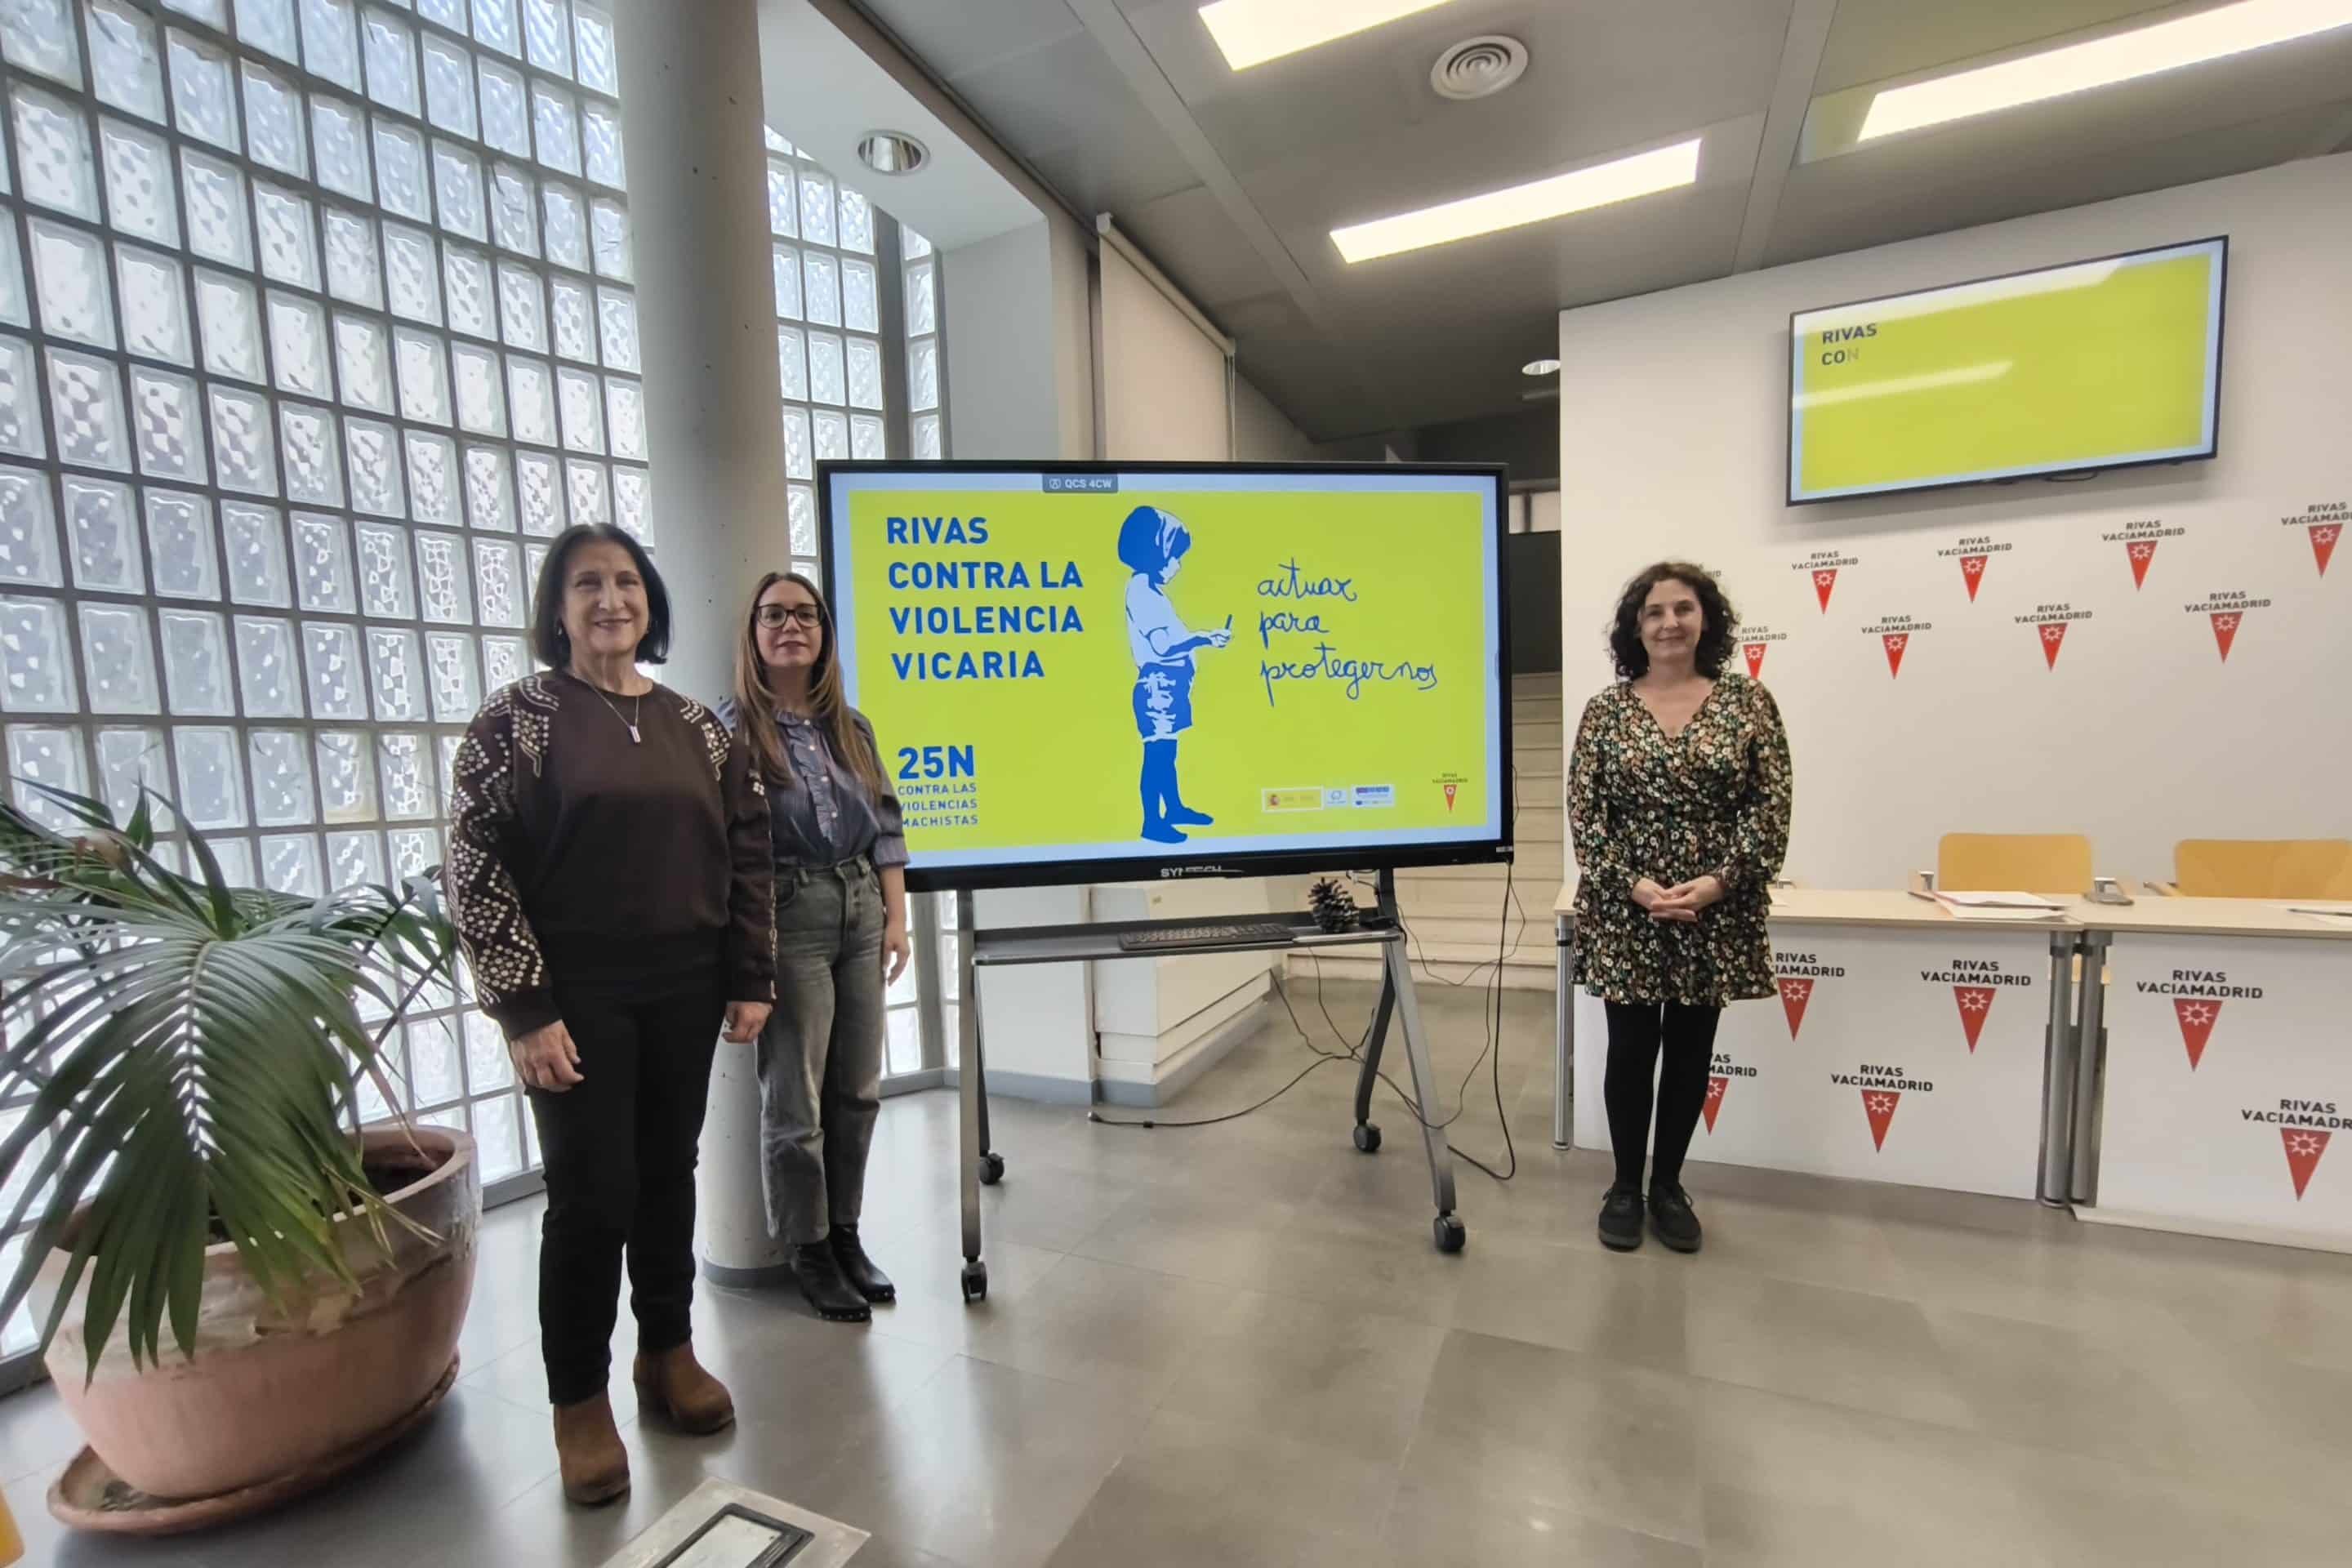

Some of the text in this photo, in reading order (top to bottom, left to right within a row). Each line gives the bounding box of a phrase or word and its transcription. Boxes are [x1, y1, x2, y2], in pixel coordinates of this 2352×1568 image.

[1822, 323, 1877, 345] RIVAS
[1065, 479, 1111, 489] QCS 4CW
[2307, 501, 2347, 513] RIVAS
[2126, 520, 2161, 530] RIVAS
[2281, 511, 2352, 525] VACIAMAD
[886, 517, 988, 544] RIVAS
[2101, 527, 2185, 542] VACIAMADRID
[1959, 537, 1990, 546] RIVAS
[1811, 551, 1839, 560] RIVAS
[1937, 543, 2012, 556] VACIAMADRID
[1791, 558, 1859, 570] VACIAMADRID
[888, 561, 1084, 589] CONTRA LA
[2210, 591, 2246, 602] RIVAS
[2037, 604, 2070, 612] RIVAS
[2184, 599, 2272, 613] VACIAMADRID
[889, 605, 1084, 635] VIOLENCIA
[1881, 615, 1912, 624] RIVAS
[2014, 611, 2092, 624] VACIAMADRID
[1259, 611, 1330, 649] para
[1742, 626, 1769, 635] RIVAS
[1861, 622, 1932, 635] VACIAMADRID
[891, 651, 1045, 680] VICARIA
[1260, 641, 1438, 707] protegernos
[898, 744, 974, 780] 25N
[898, 783, 977, 795] CONTRA LAS
[1776, 952, 1817, 964] RIVAS
[1775, 964, 1845, 978] IAMADRID
[1952, 960, 2000, 972] RIVAS
[1921, 971, 2031, 987] VACIAMADRID
[2172, 969, 2226, 983] RIVAS
[2136, 982, 2263, 1000] VACIAMADRID
[1860, 1064, 1904, 1078] RIVAS
[1831, 1074, 1934, 1093] VACIAMADRID
[2280, 1099, 2336, 1114] RIVAS
[2241, 1109, 2352, 1129] VACIAMADR
